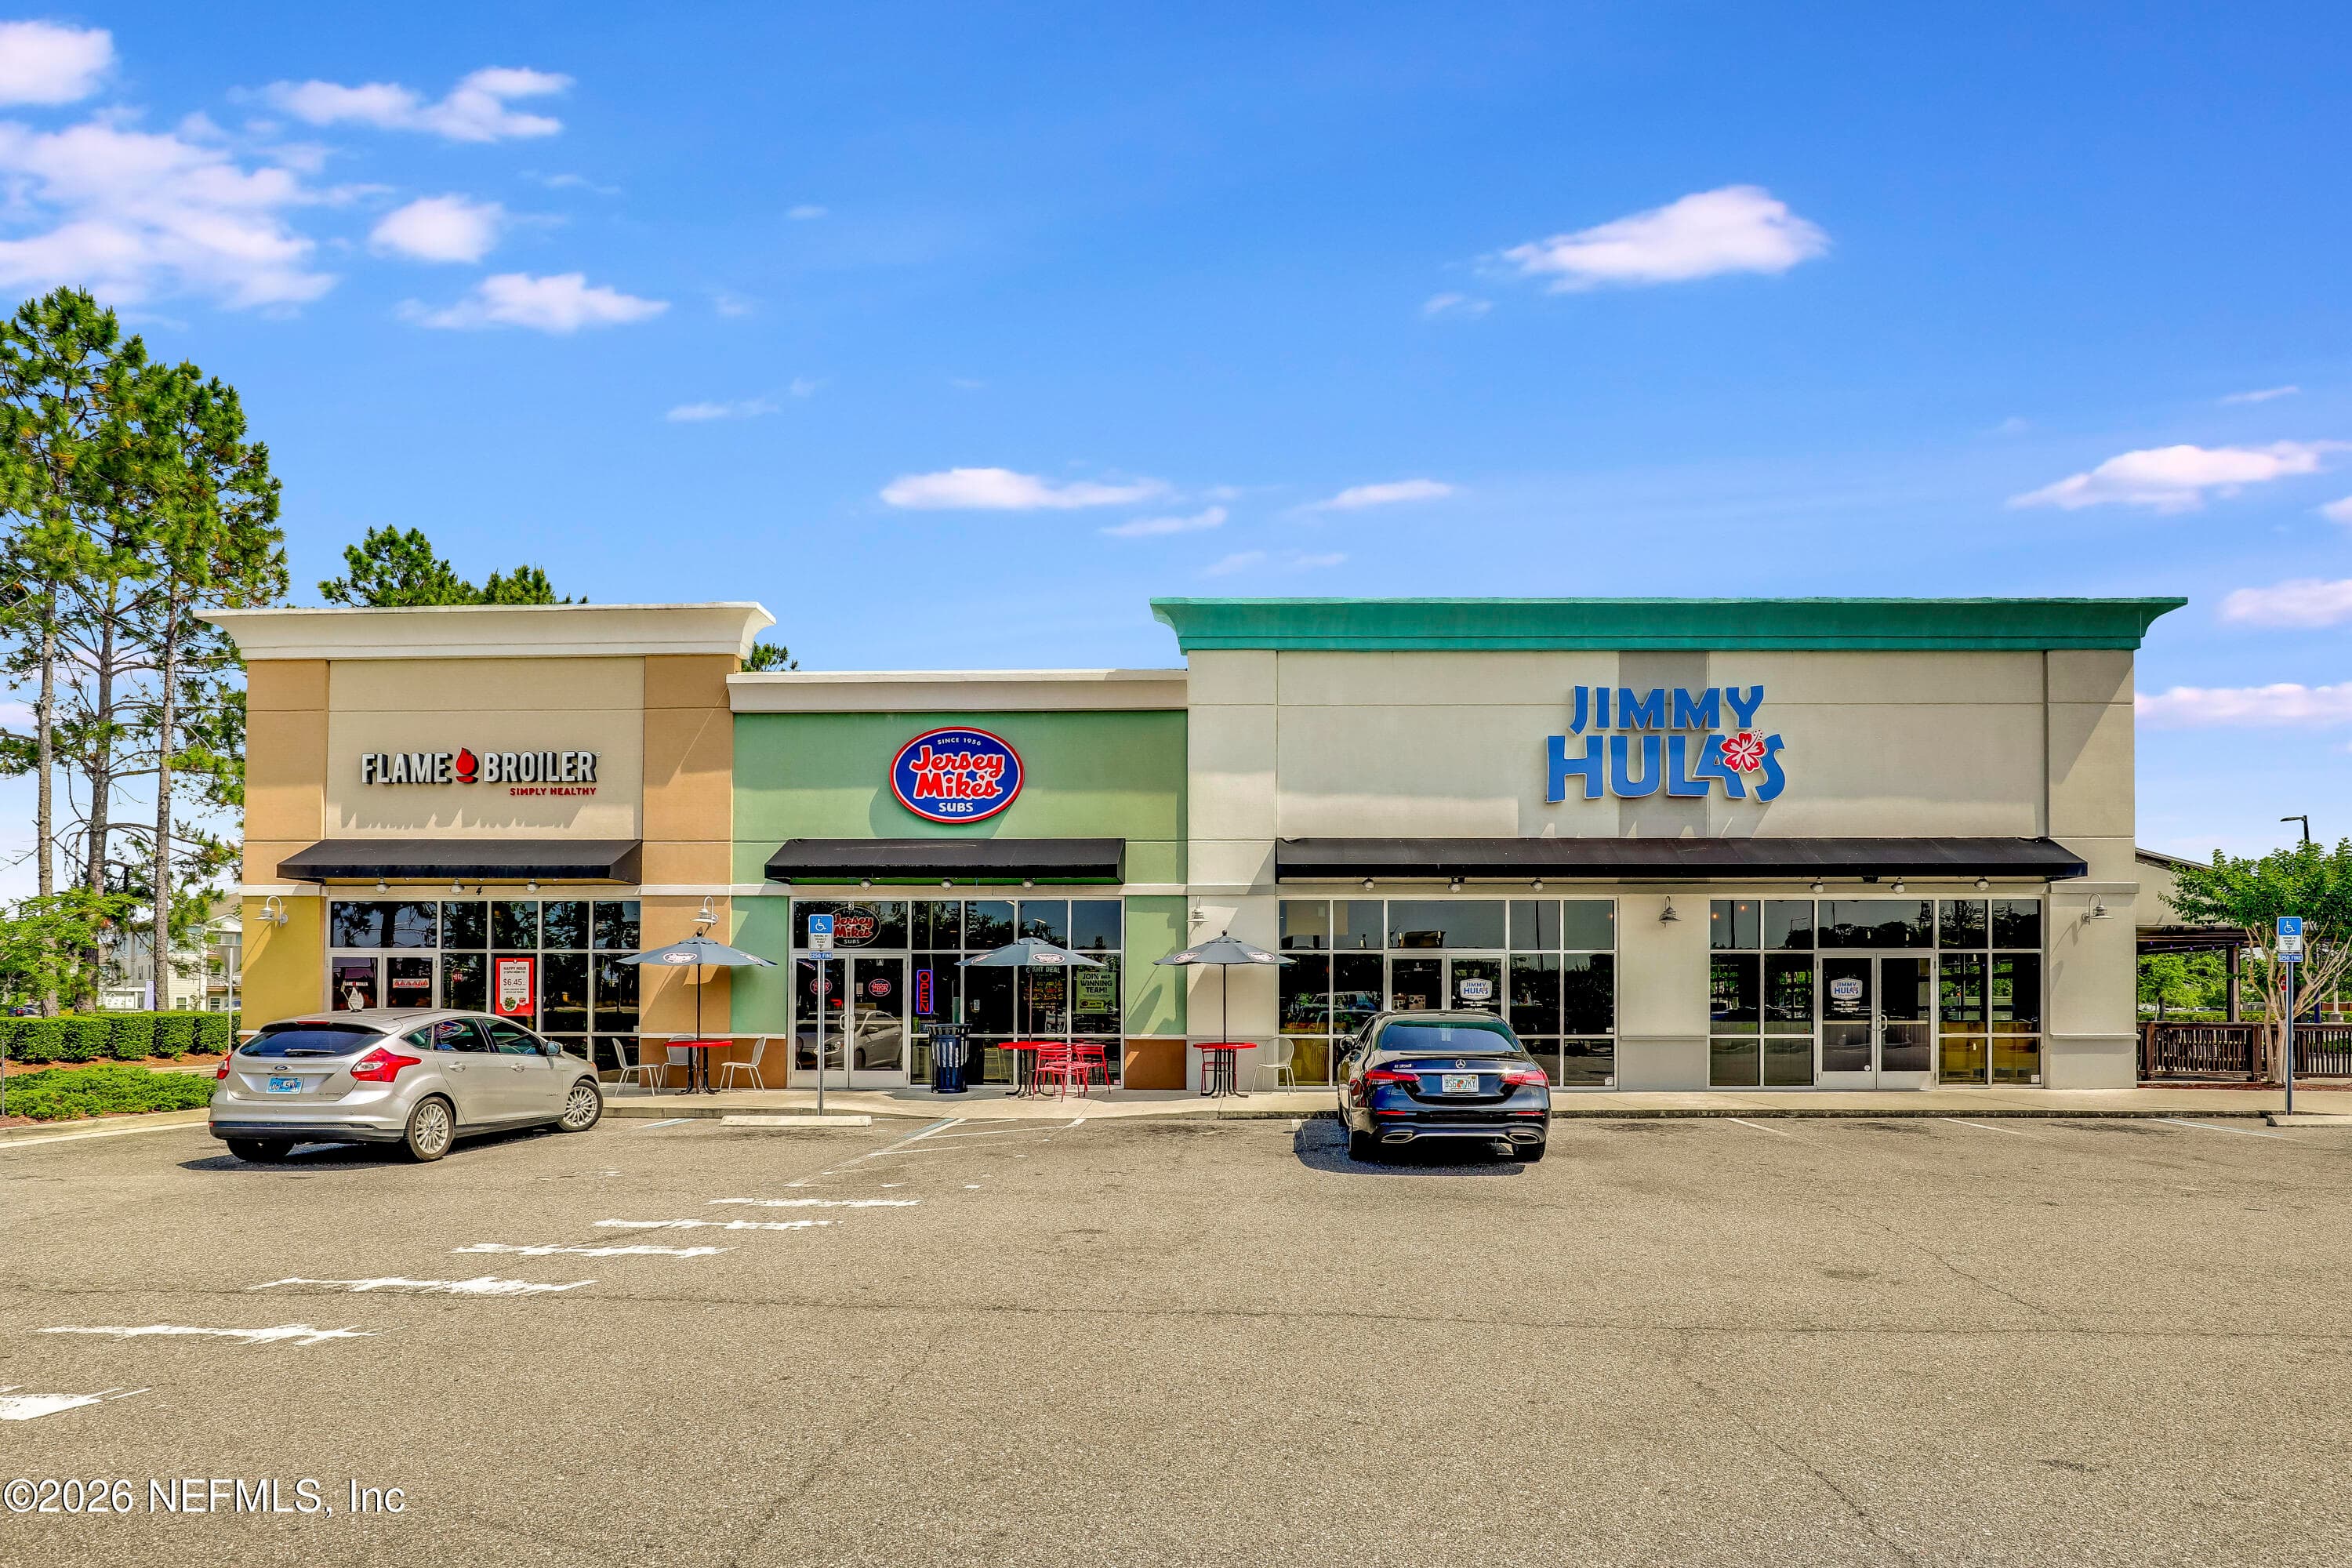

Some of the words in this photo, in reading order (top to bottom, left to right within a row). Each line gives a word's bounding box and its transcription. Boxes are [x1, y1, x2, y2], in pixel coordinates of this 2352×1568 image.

[1569, 684, 1765, 735] JIMMY
[361, 753, 452, 783] FLAME
[484, 751, 597, 782] BROILER
[909, 745, 1005, 779] Jersey
[510, 787, 546, 796] SIMPLY
[550, 787, 597, 796] HEALTHY
[913, 771, 1004, 800] Mike's
[938, 802, 974, 812] SUBS
[833, 913, 874, 928] Jersey
[919, 971, 931, 1012] OPEN
